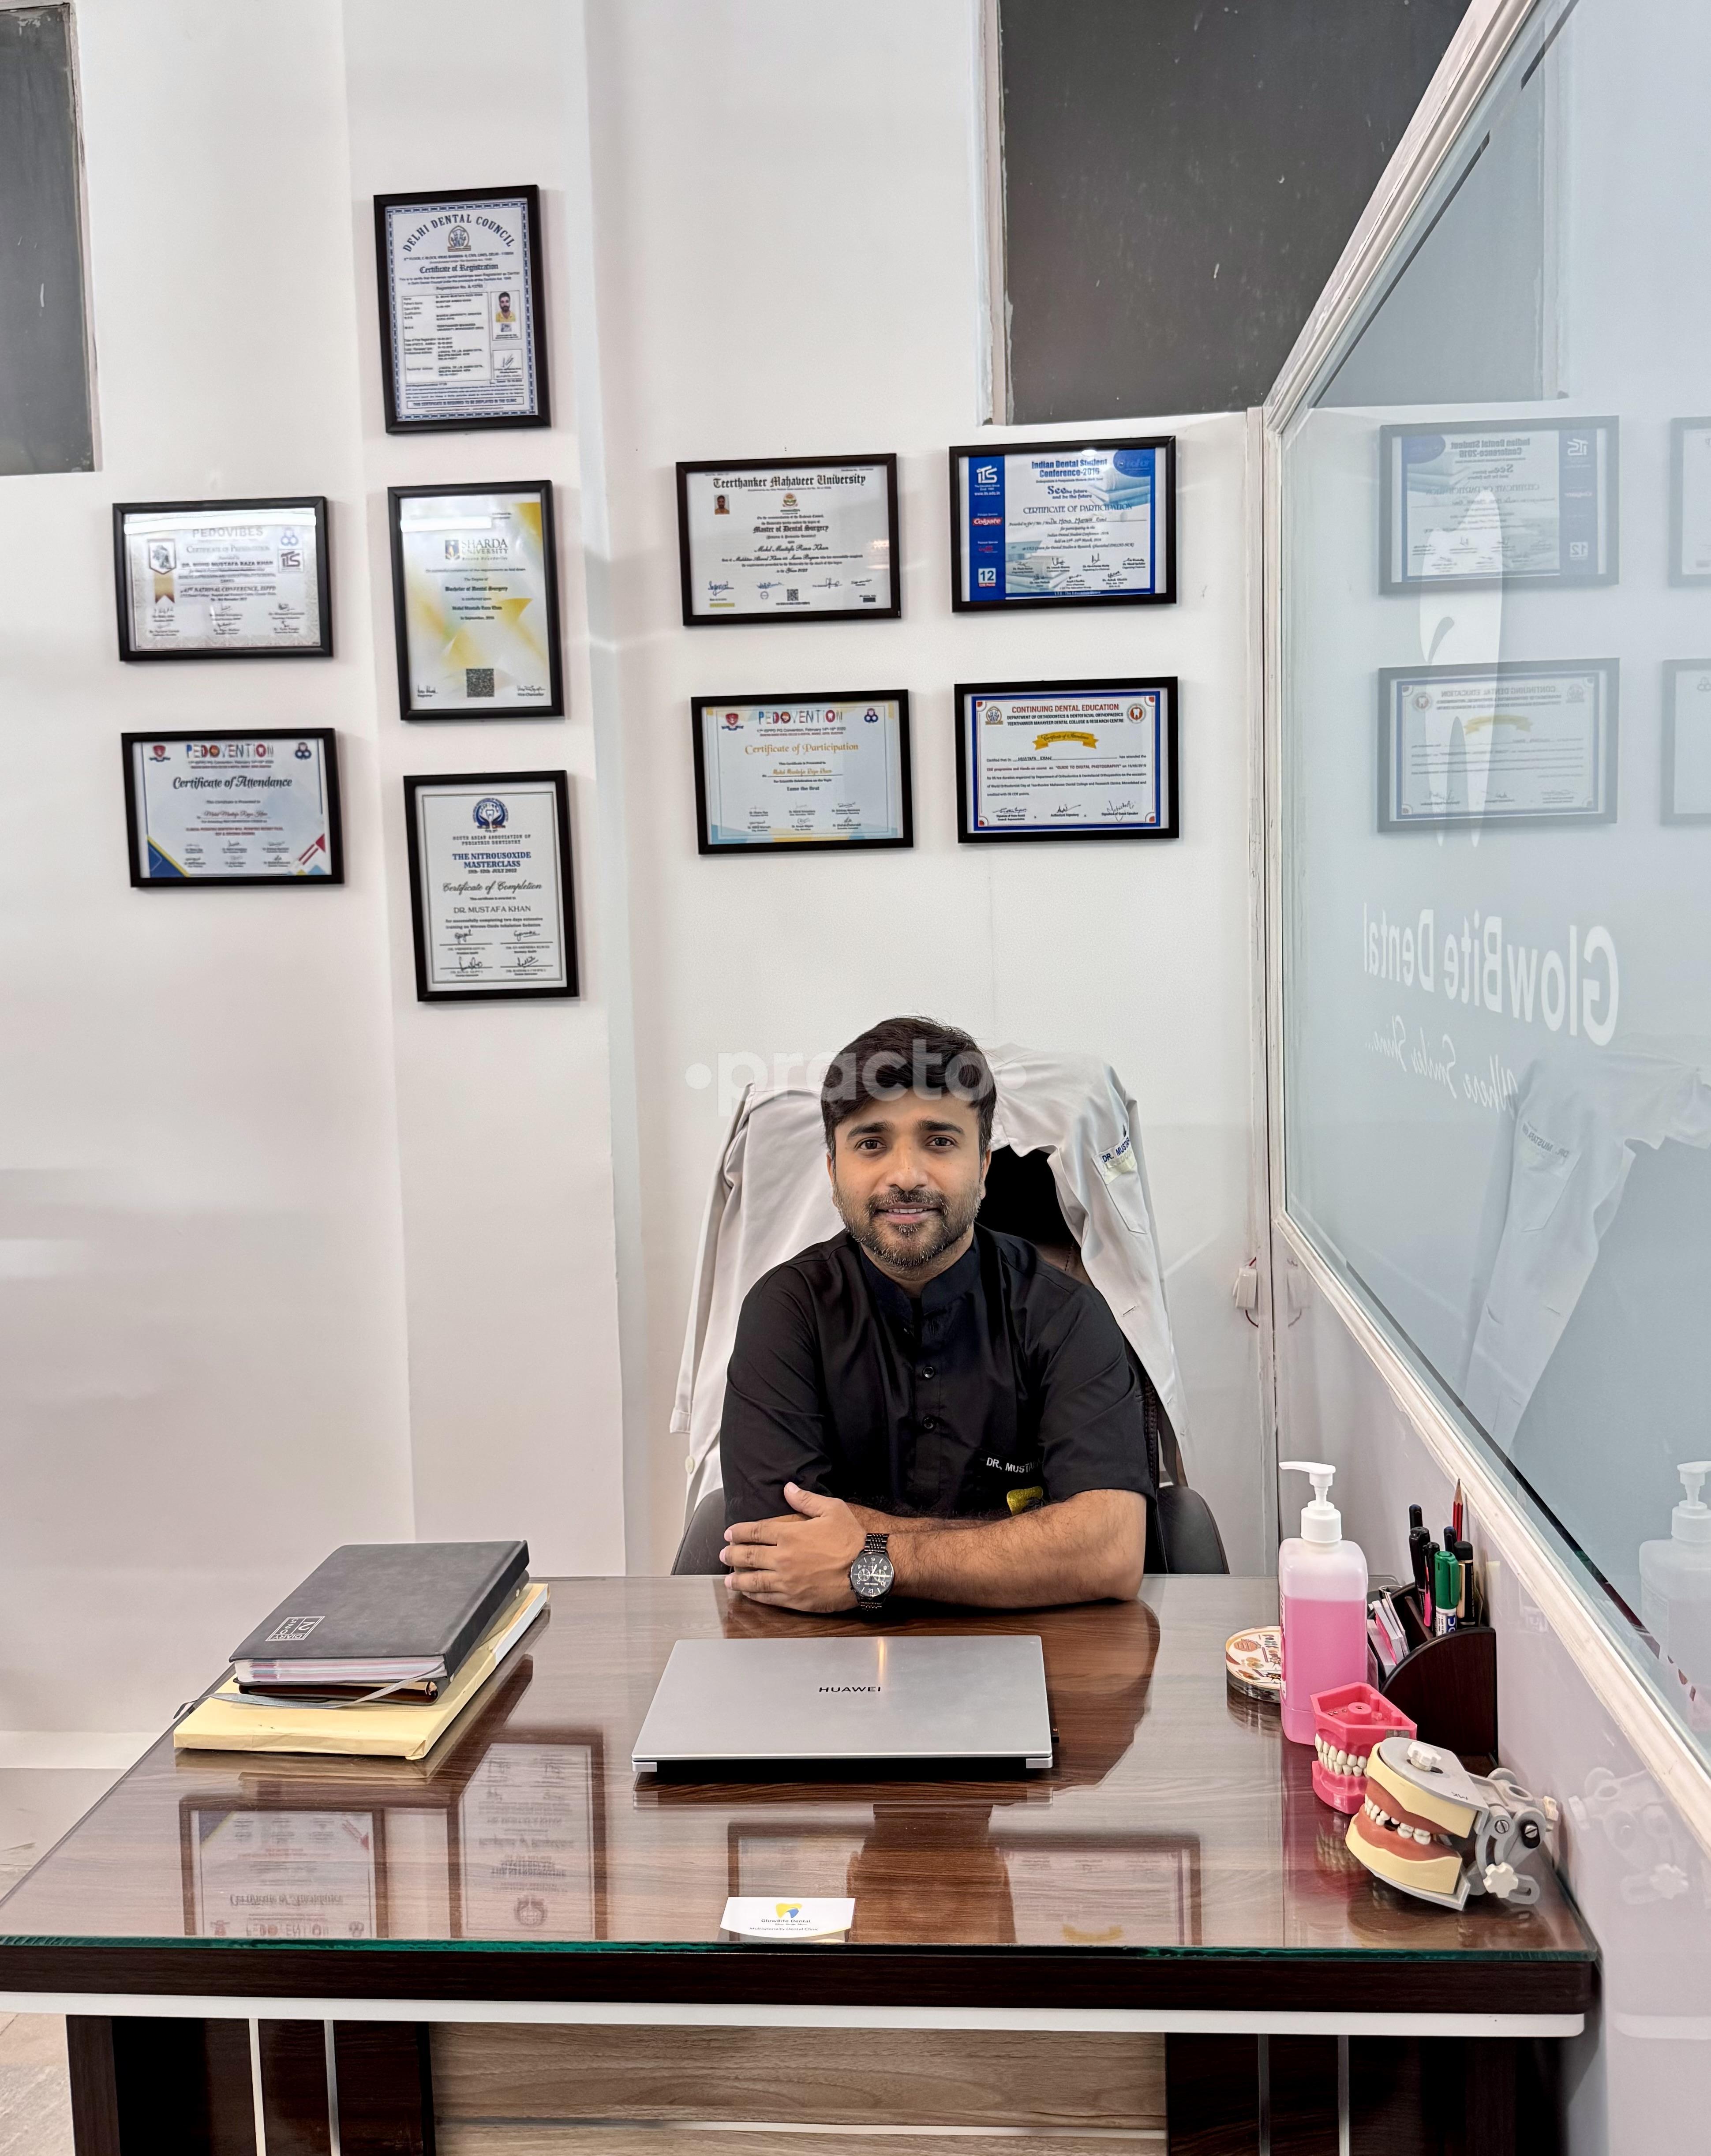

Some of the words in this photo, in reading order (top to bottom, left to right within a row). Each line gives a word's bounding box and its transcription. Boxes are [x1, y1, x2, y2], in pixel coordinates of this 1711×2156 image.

[403, 225, 429, 252] DELHI
[431, 214, 472, 229] DENTAL
[476, 216, 515, 247] COUNCIL
[419, 266, 450, 274] Certificate
[459, 264, 498, 272] Registration
[1032, 461, 1054, 469] Indian
[1040, 468, 1100, 477] Conference-2016
[713, 476, 767, 490] Teerthanker
[770, 476, 814, 488] Mahaveer
[817, 473, 866, 486] University
[1047, 486, 1066, 495] See
[1079, 503, 1132, 512] PARTICIPATION
[462, 539, 508, 548] SHARDA
[980, 570, 994, 581] 12
[745, 744, 790, 756] Certificate
[792, 743, 800, 755] of
[802, 742, 858, 754] Participation
[173, 776, 222, 790] Certificate
[224, 776, 236, 789] of
[235, 775, 292, 789] Attendance
[471, 851, 532, 860] NITROUSOXIDE
[442, 881, 483, 895] Certificate
[485, 880, 496, 895] of
[498, 879, 543, 894] Completion
[1102, 1153, 1114, 1163] DR.
[986, 1457, 1002, 1470] DR.
